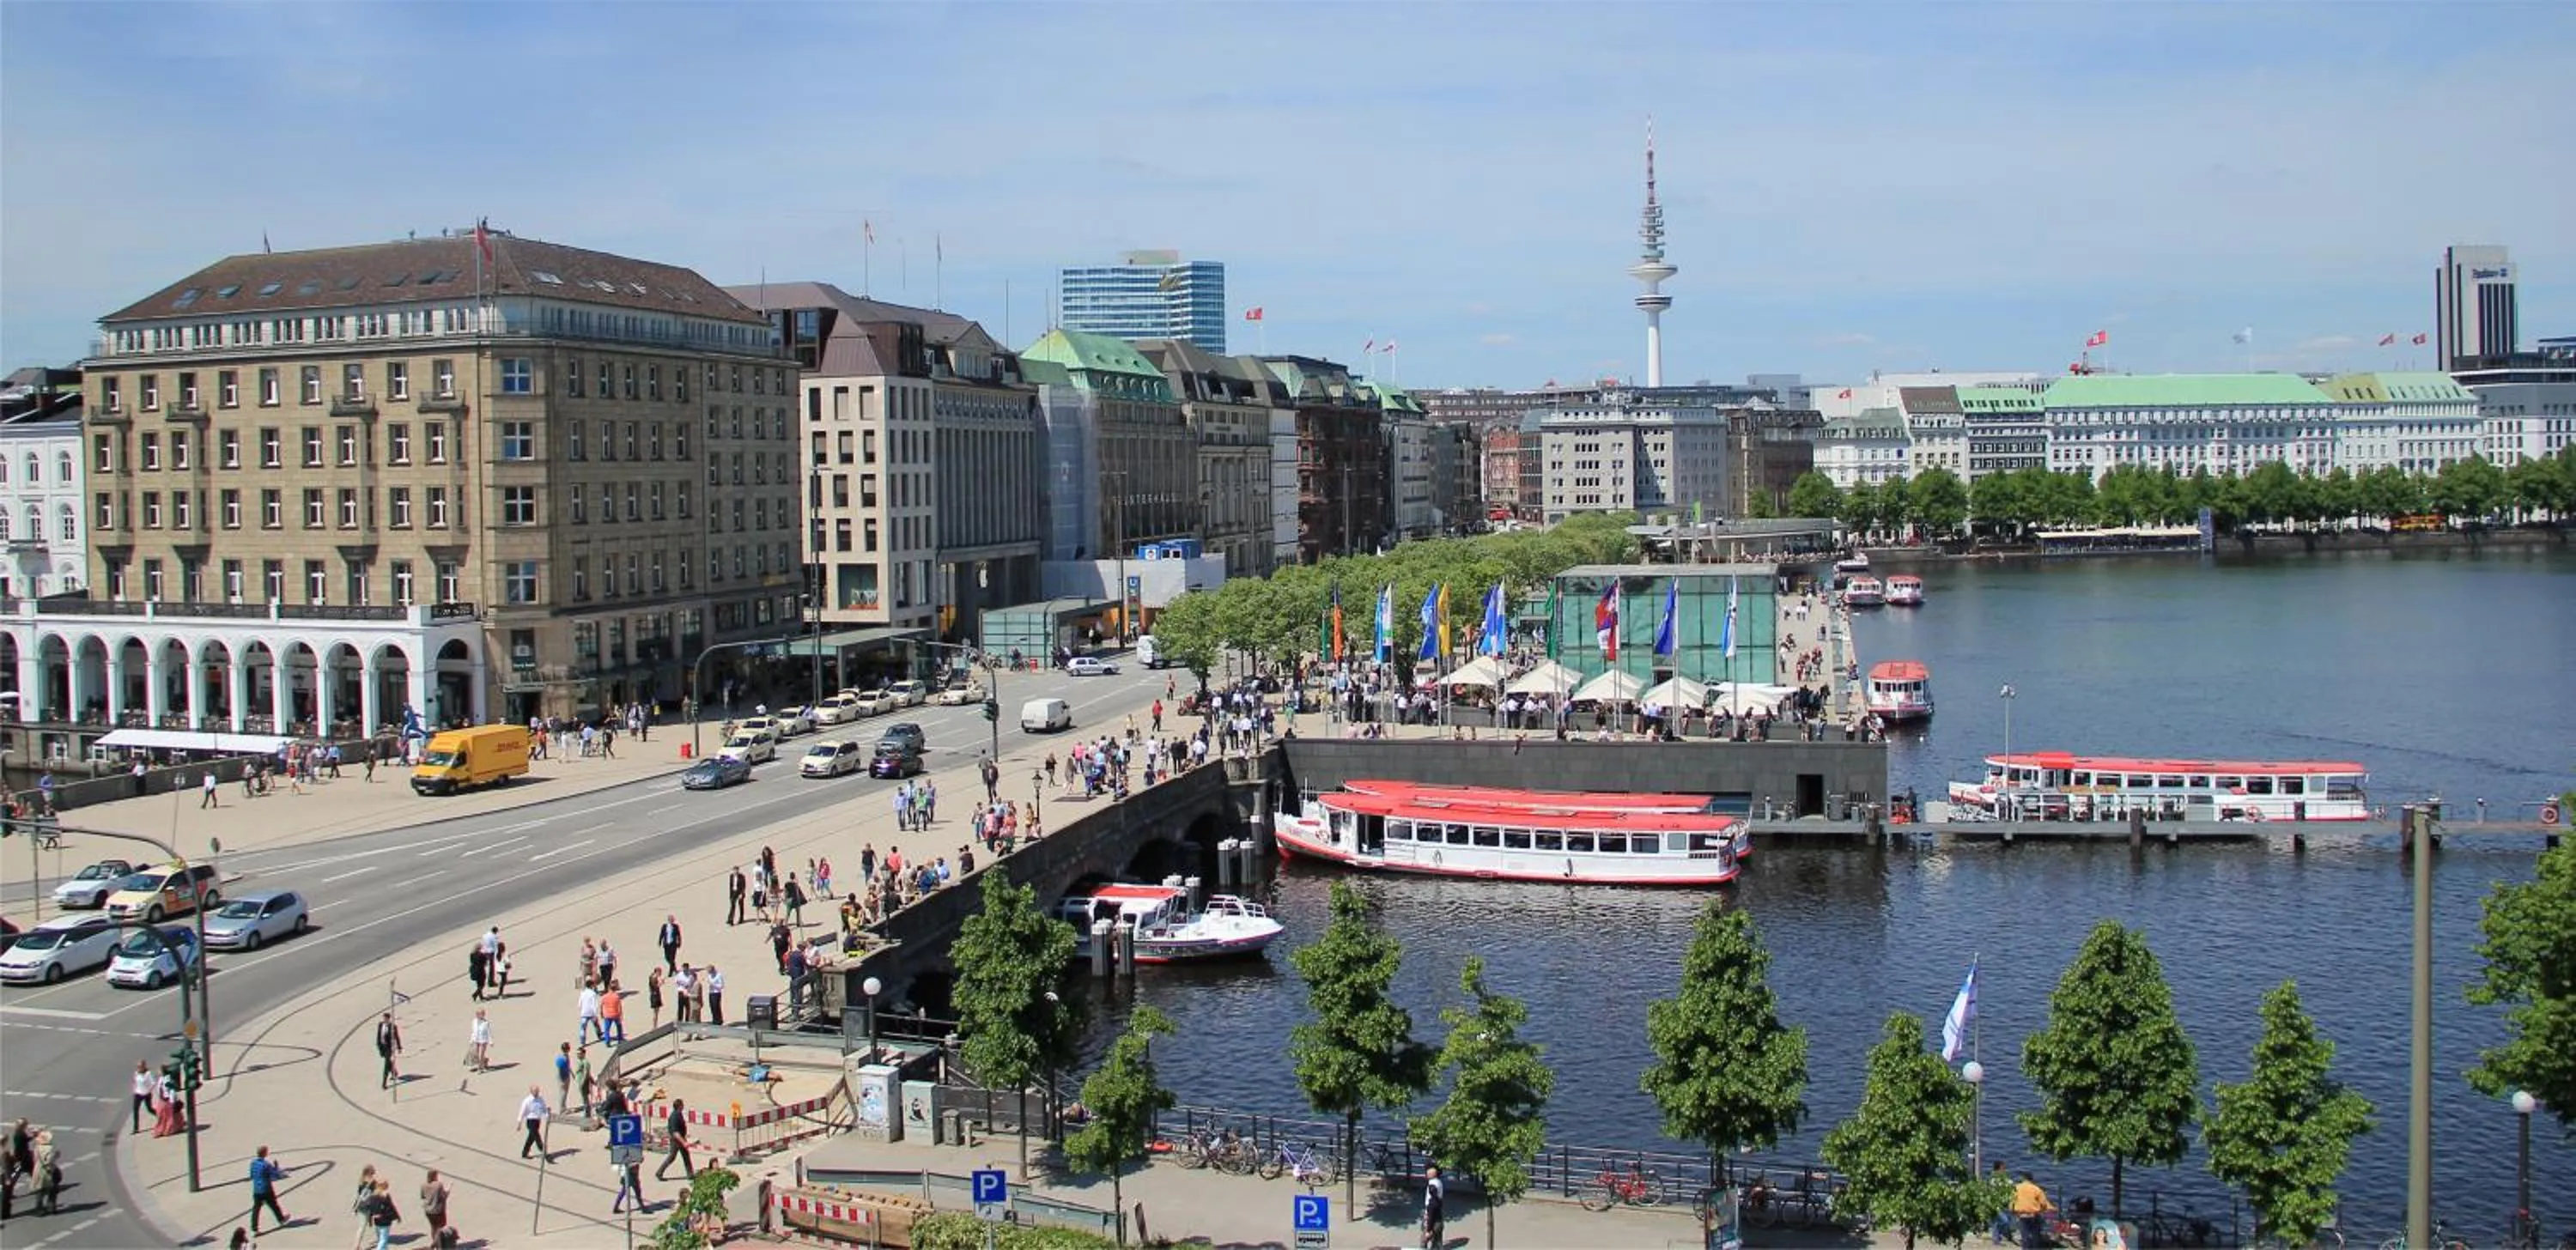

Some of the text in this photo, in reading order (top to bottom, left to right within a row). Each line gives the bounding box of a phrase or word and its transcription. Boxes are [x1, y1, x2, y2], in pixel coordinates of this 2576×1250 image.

[617, 1120, 635, 1142] P
[980, 1174, 998, 1198] P
[1299, 1199, 1317, 1225] P
